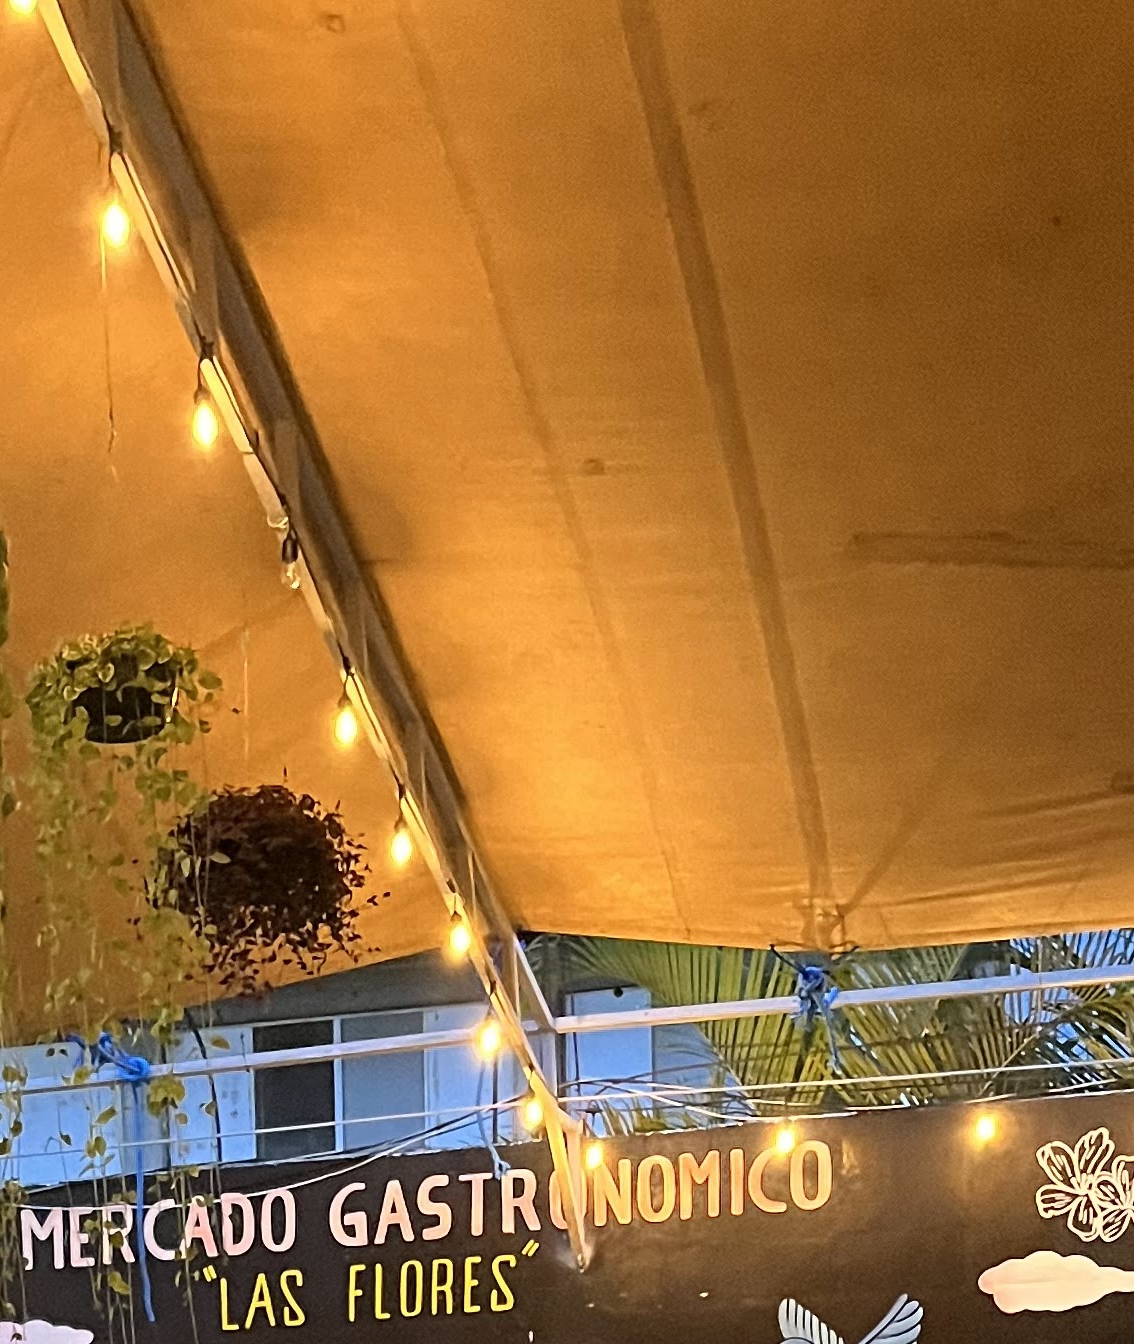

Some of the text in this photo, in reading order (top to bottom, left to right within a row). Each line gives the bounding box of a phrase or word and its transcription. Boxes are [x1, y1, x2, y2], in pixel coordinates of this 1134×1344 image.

[19, 1140, 833, 1271] MERCADO GASTRONOMICO
[203, 1239, 540, 1332] "LAS FLORES"
